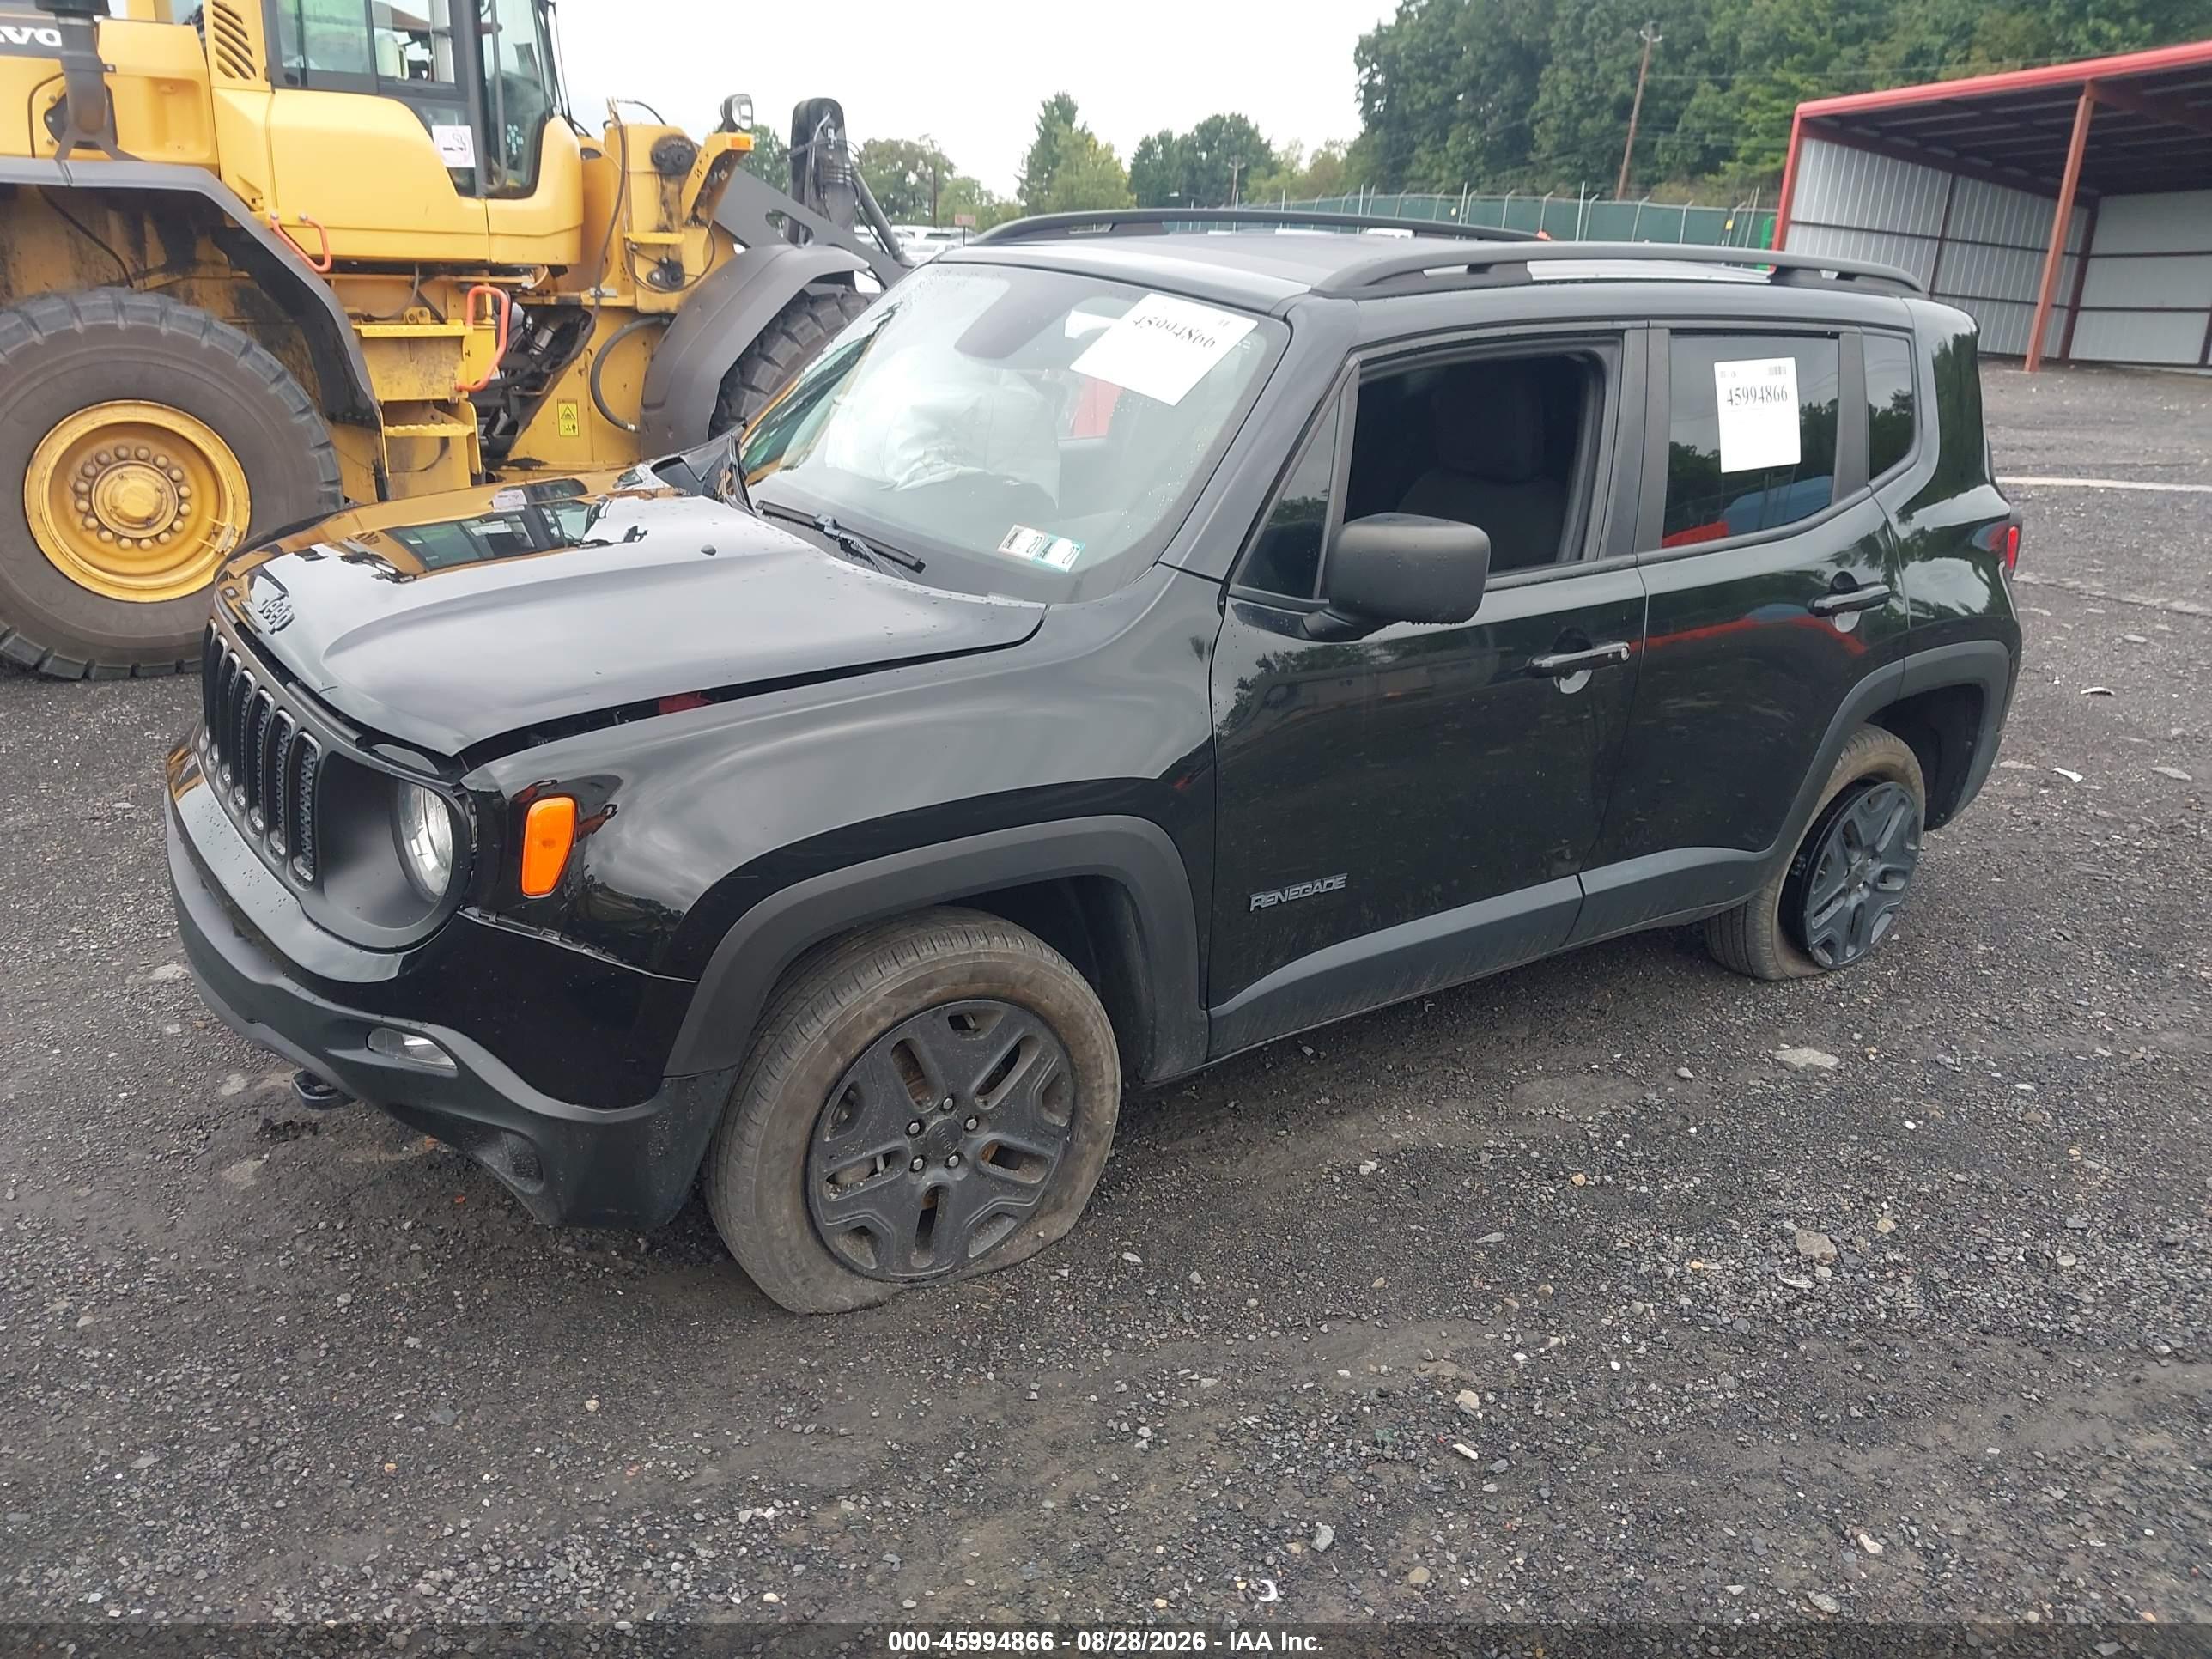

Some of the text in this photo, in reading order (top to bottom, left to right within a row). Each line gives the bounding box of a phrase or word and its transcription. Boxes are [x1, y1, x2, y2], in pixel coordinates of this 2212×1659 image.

[0, 26, 62, 47] VO
[1726, 385, 1788, 406] 45994866
[258, 599, 295, 635] Jeep
[1250, 873, 1347, 912] RENEGADE
